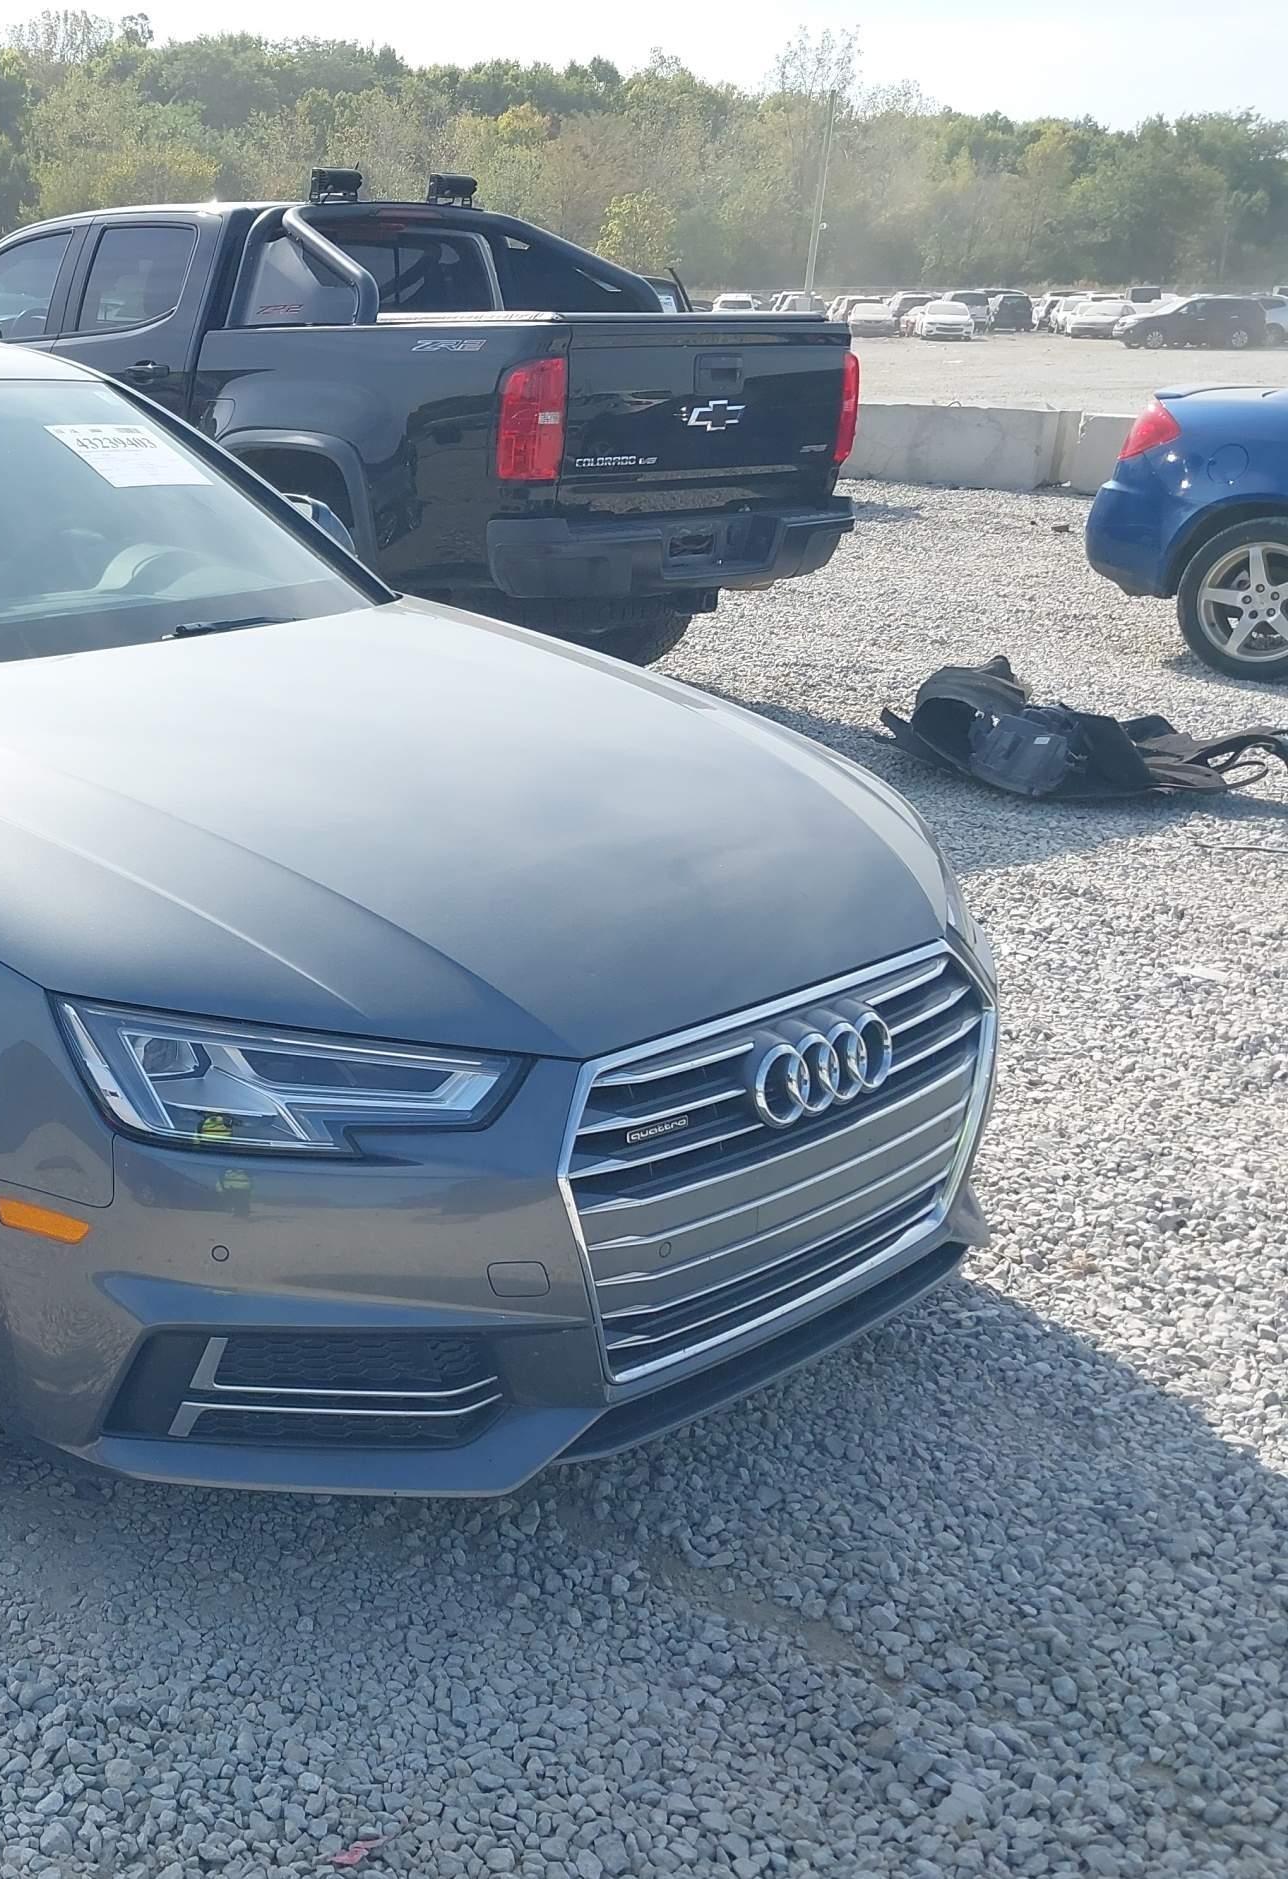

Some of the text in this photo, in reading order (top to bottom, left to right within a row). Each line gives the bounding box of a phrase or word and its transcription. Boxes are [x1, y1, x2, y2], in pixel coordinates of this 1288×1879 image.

[411, 339, 487, 352] ZR2
[75, 435, 159, 450] 43239403
[575, 456, 637, 468] COLORADO
[630, 1118, 687, 1141] quattro
